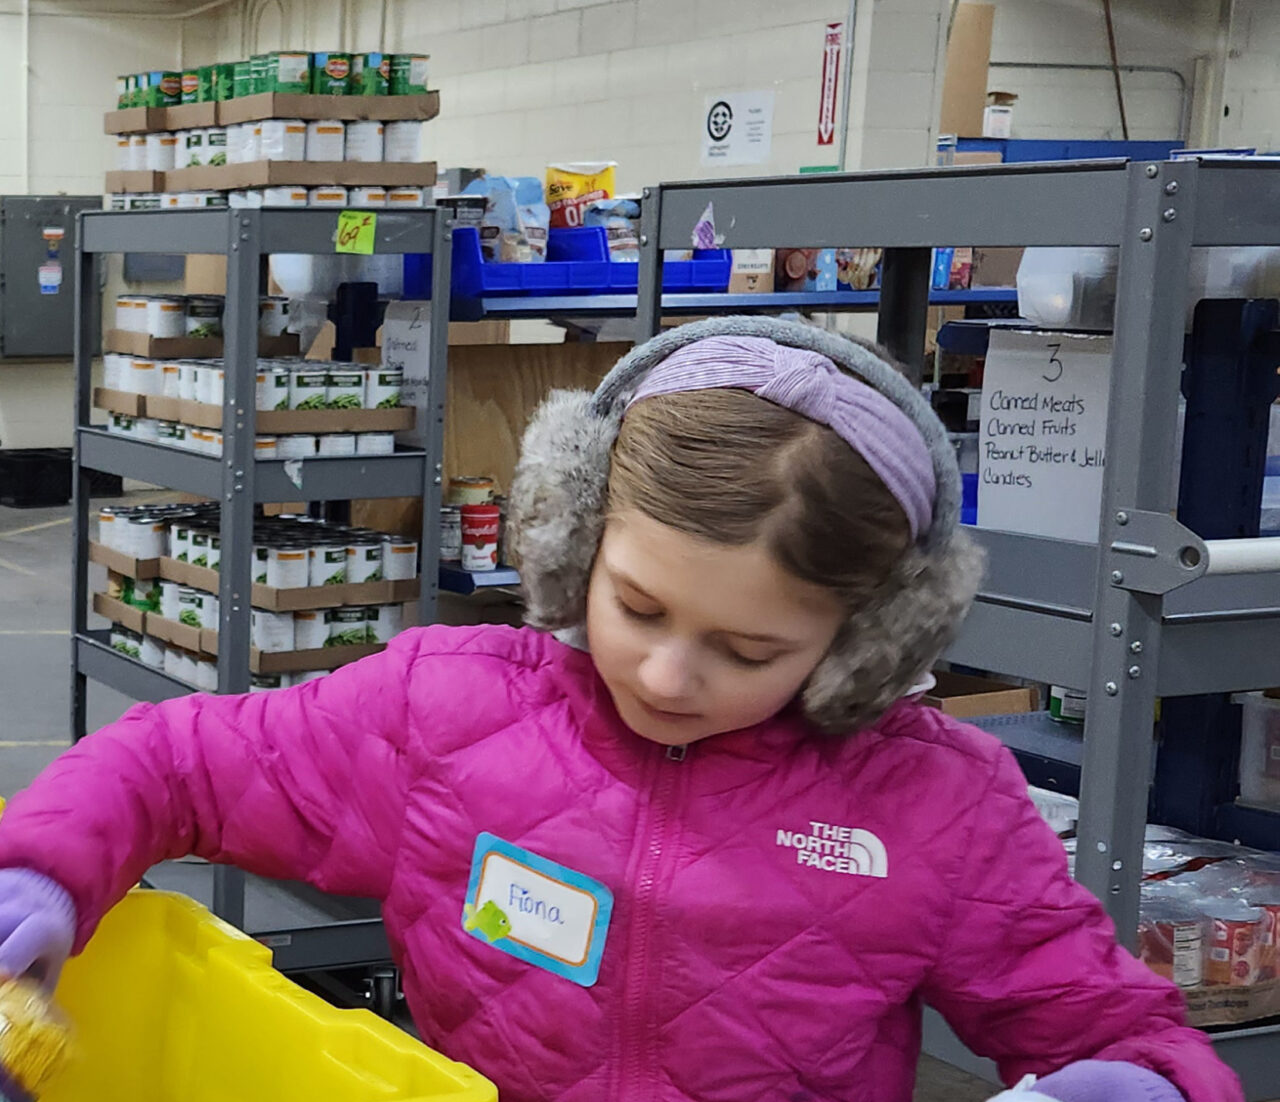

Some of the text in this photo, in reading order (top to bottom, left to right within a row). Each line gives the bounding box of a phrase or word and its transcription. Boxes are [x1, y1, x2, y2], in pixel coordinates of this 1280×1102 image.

[1042, 343, 1063, 383] 3
[1042, 394, 1085, 415] Meats
[1042, 418, 1076, 436] Fruits
[985, 441, 1024, 460] Peanut
[1027, 445, 1069, 464] Butter
[983, 467, 1032, 489] Candies
[809, 821, 851, 842] THE
[776, 829, 851, 858] NORTH
[797, 849, 851, 874] FACE
[508, 882, 565, 926] Fiona
